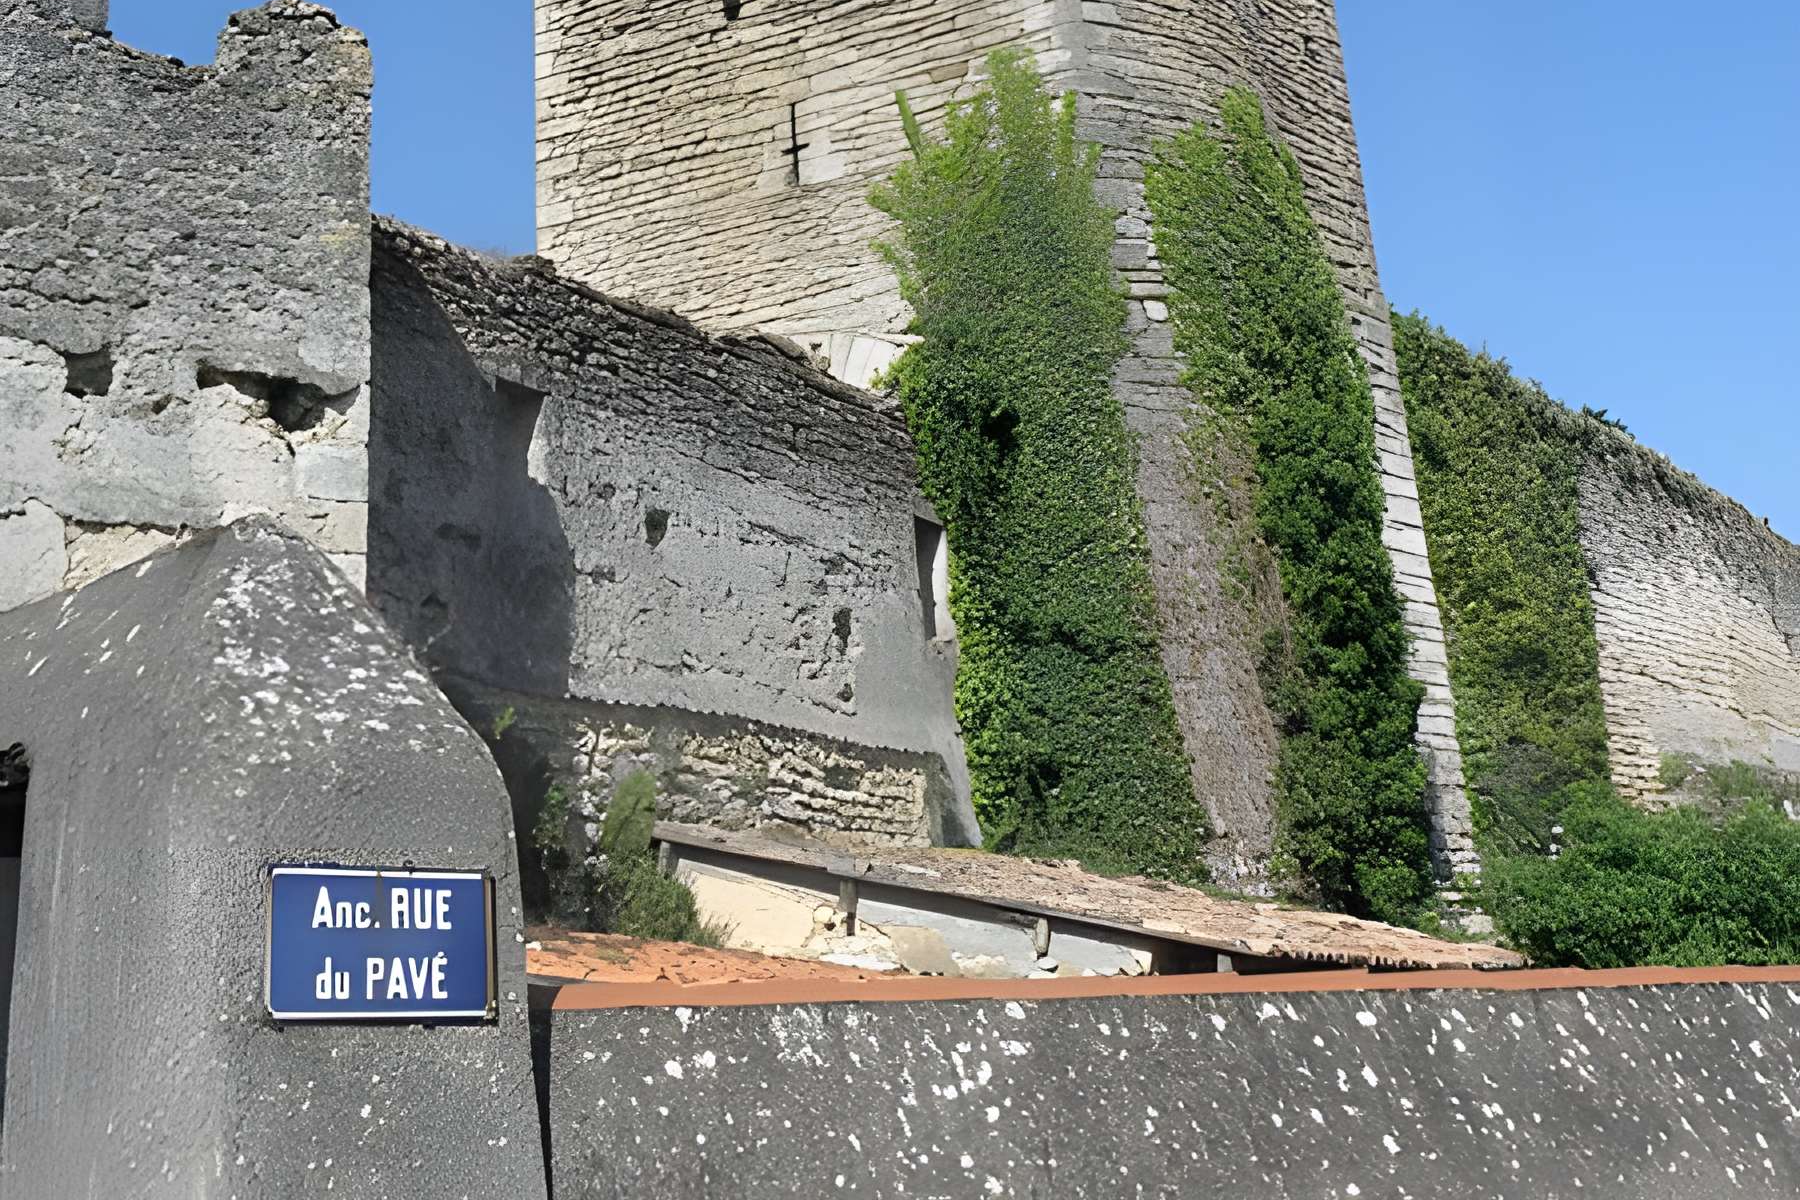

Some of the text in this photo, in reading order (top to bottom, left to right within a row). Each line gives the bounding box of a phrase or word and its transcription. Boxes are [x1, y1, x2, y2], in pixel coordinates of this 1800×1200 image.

[311, 885, 453, 930] Anc. RUE
[315, 951, 449, 1000] du PAVÉ
